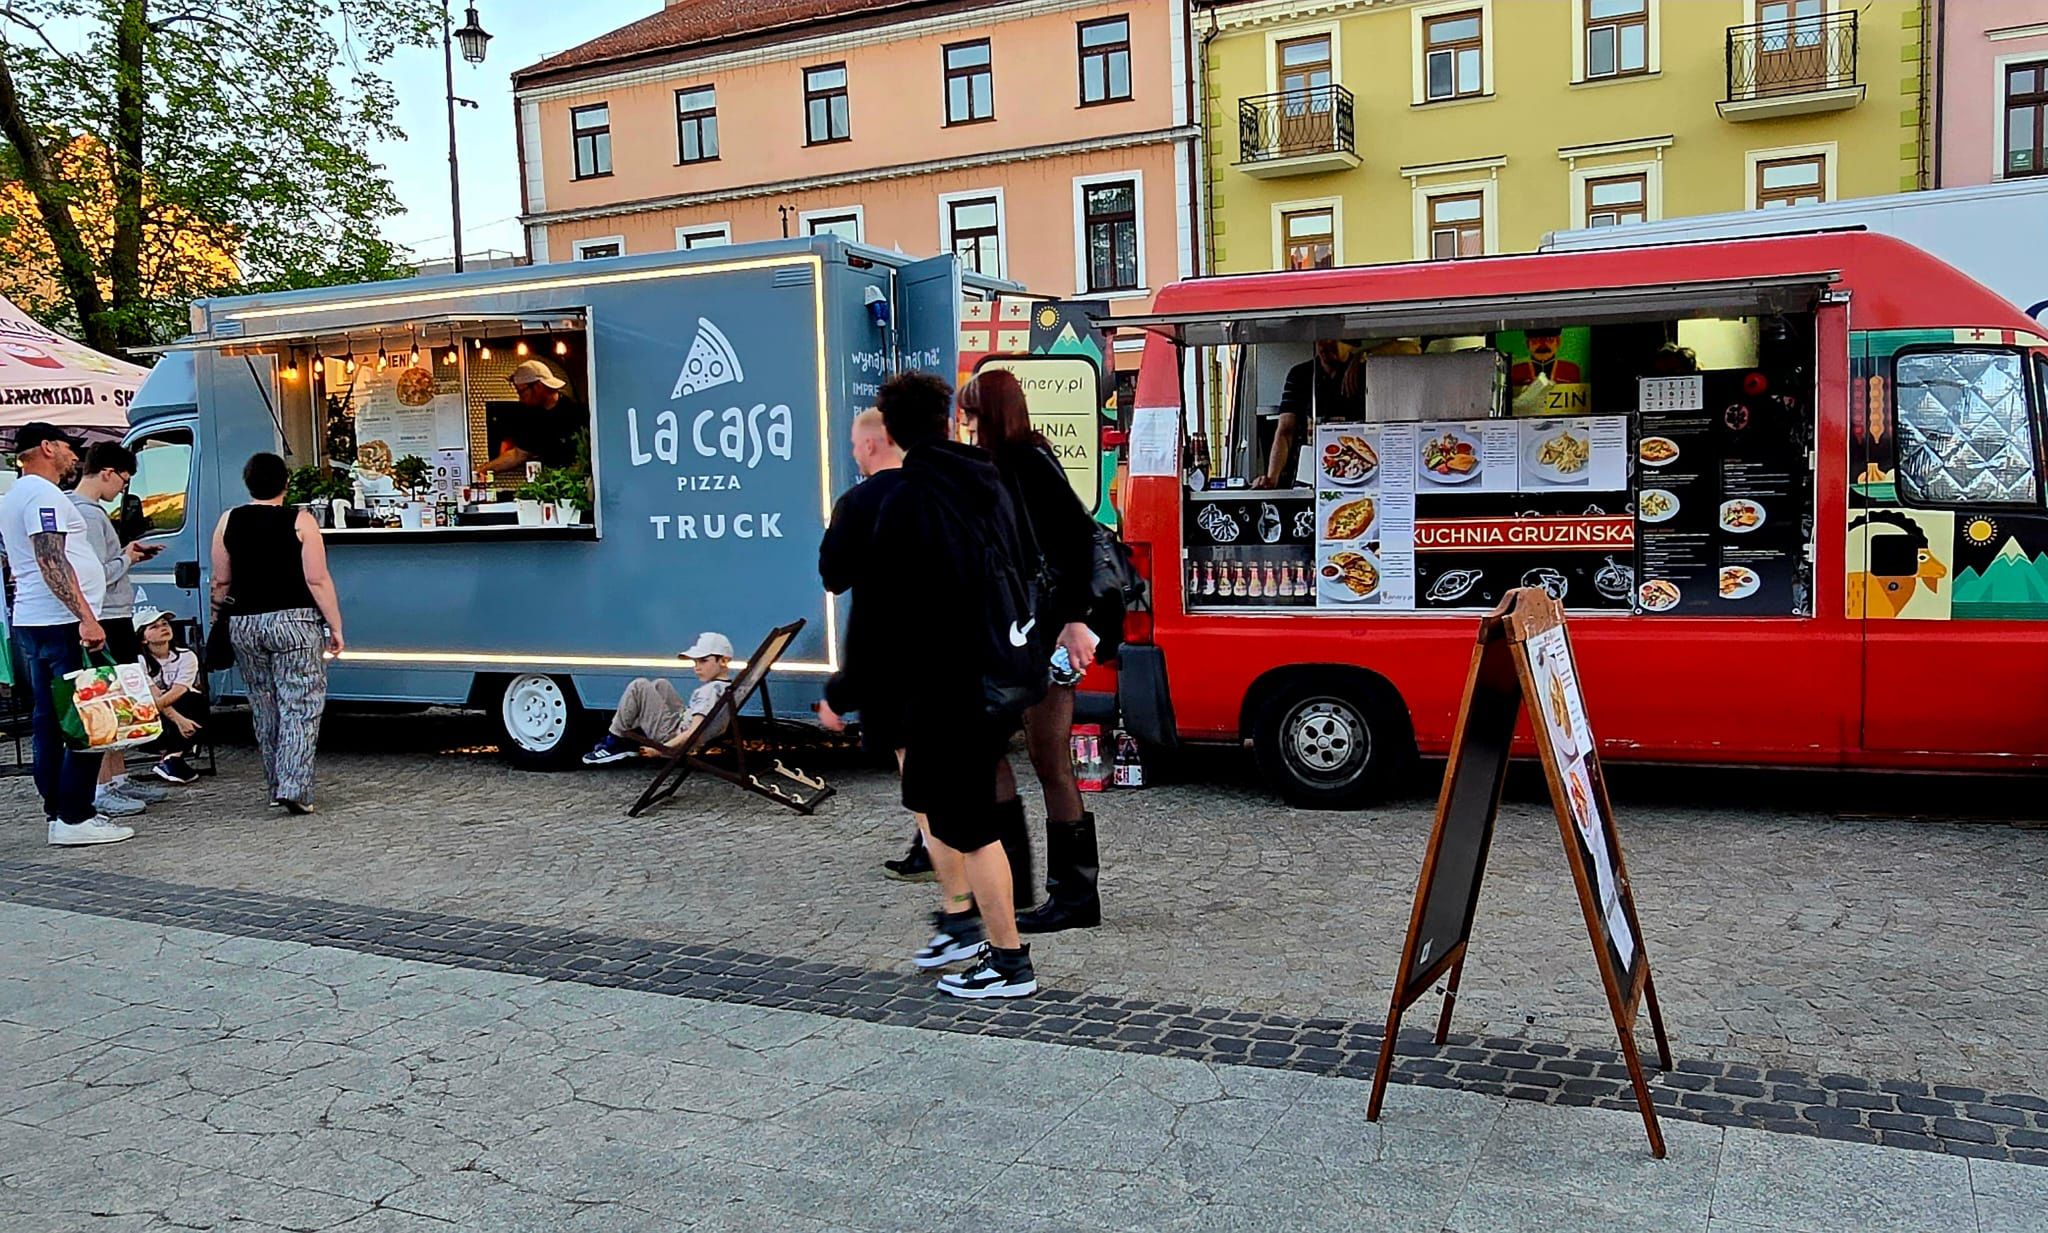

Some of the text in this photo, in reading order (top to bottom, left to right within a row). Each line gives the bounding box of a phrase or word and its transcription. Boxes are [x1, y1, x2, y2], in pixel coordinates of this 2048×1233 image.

[904, 350, 922, 372] nas
[853, 382, 881, 397] IMPRE
[1549, 391, 1588, 409] ZIN
[628, 407, 679, 467] La
[1033, 423, 1078, 438] HNIA
[1053, 444, 1088, 459] SKA
[676, 474, 742, 492] PIZZA
[649, 513, 783, 540] TRUCK
[1508, 523, 1634, 543] GRUZIŃSKA
